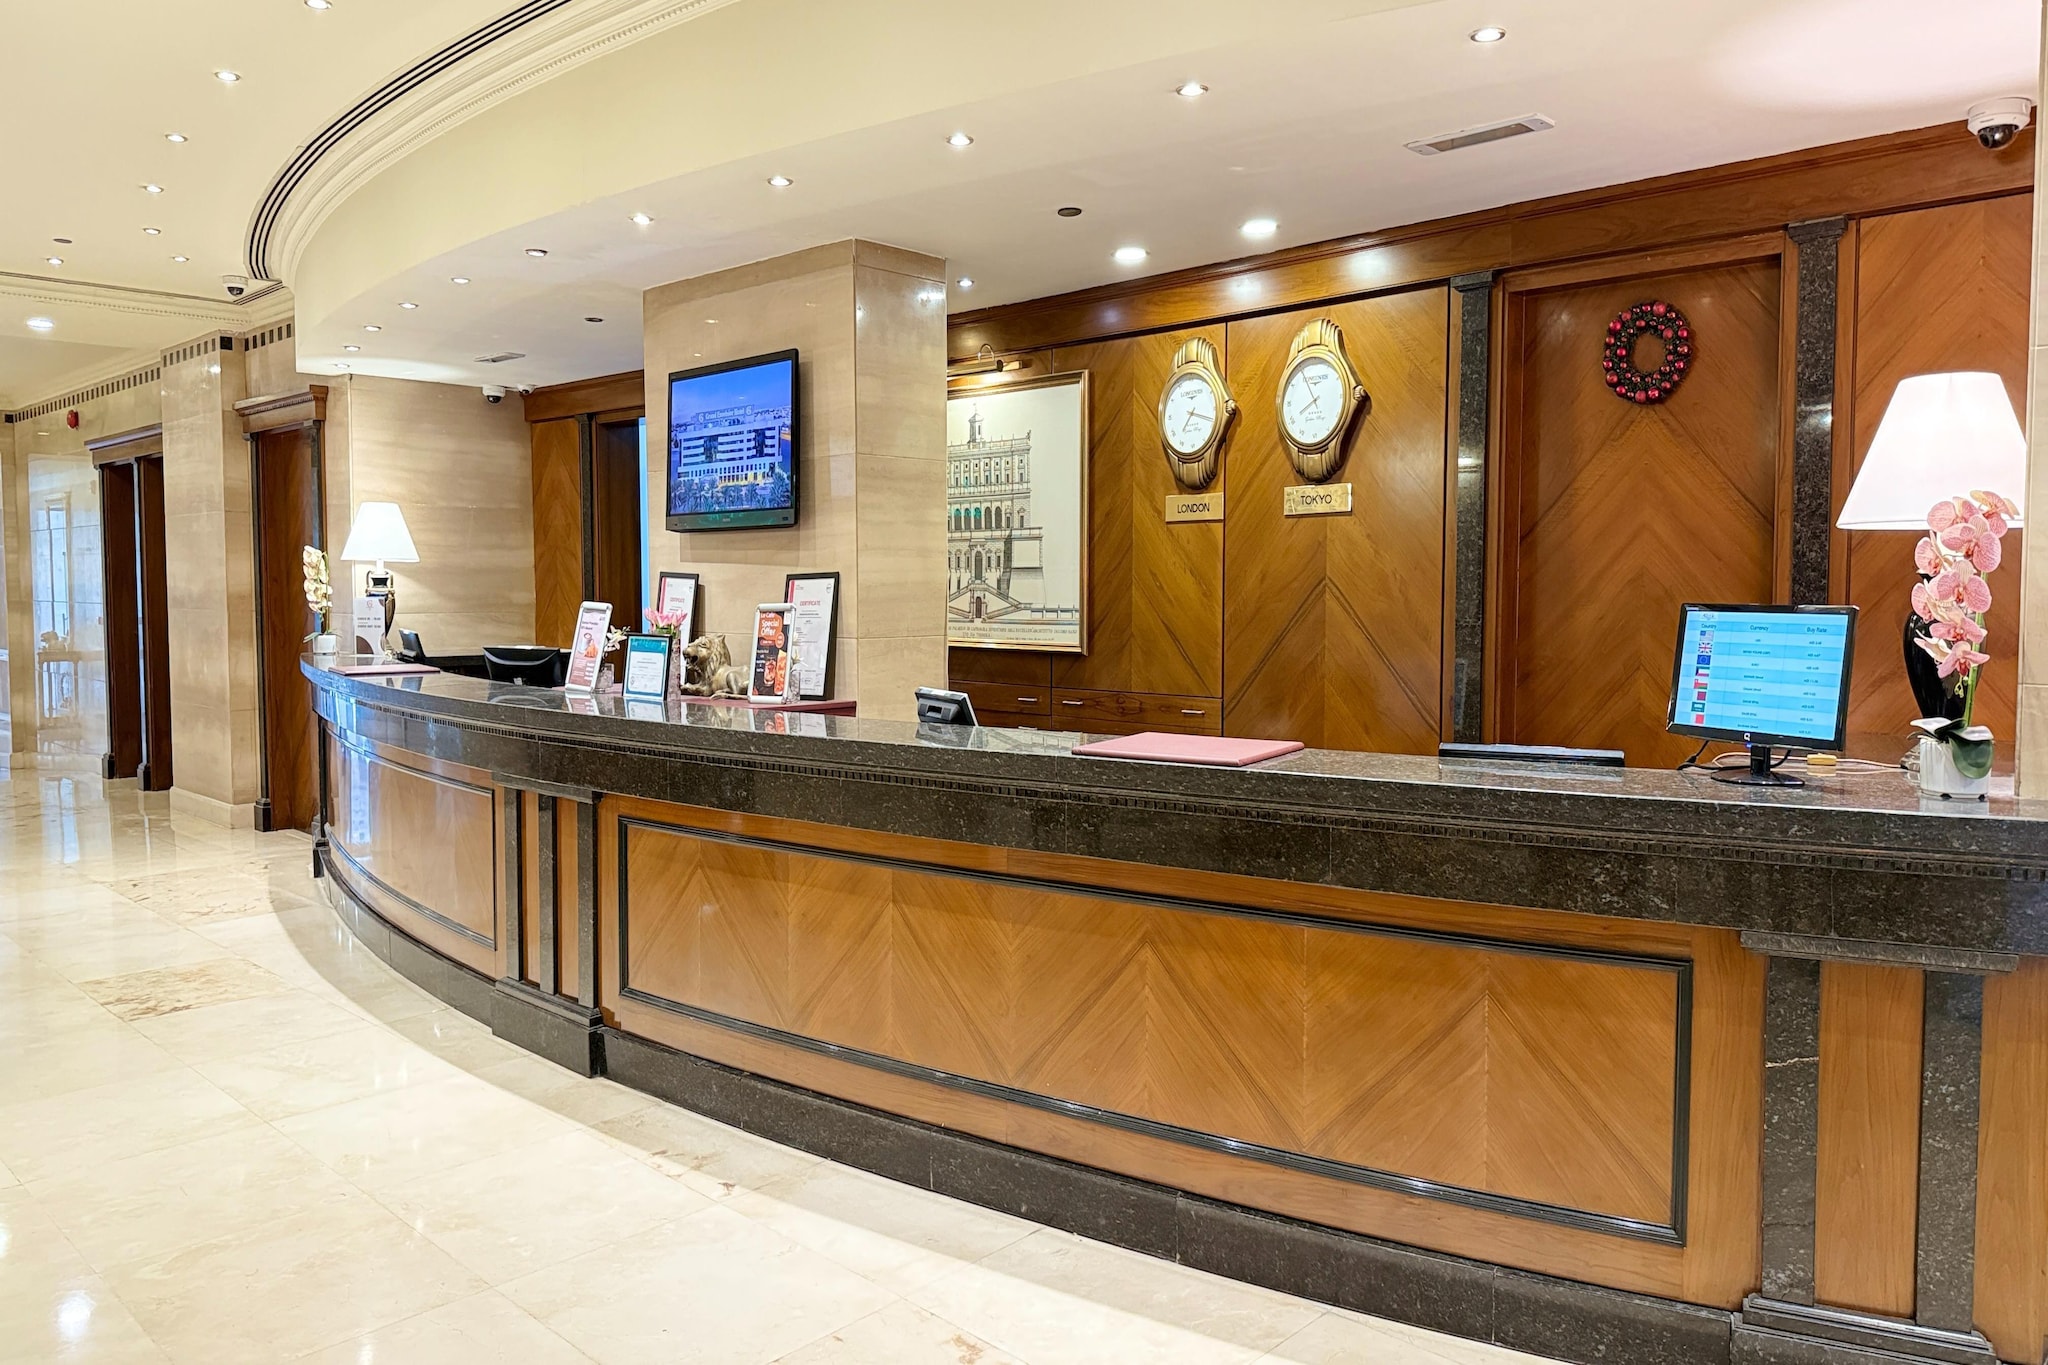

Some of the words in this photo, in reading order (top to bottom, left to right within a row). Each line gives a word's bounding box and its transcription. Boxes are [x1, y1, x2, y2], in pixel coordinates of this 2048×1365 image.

[1181, 389, 1203, 397] LONGINES
[1300, 494, 1333, 505] TOKYO
[1177, 502, 1210, 514] LONDON
[762, 619, 779, 628] Special
[761, 628, 776, 636] Offer
